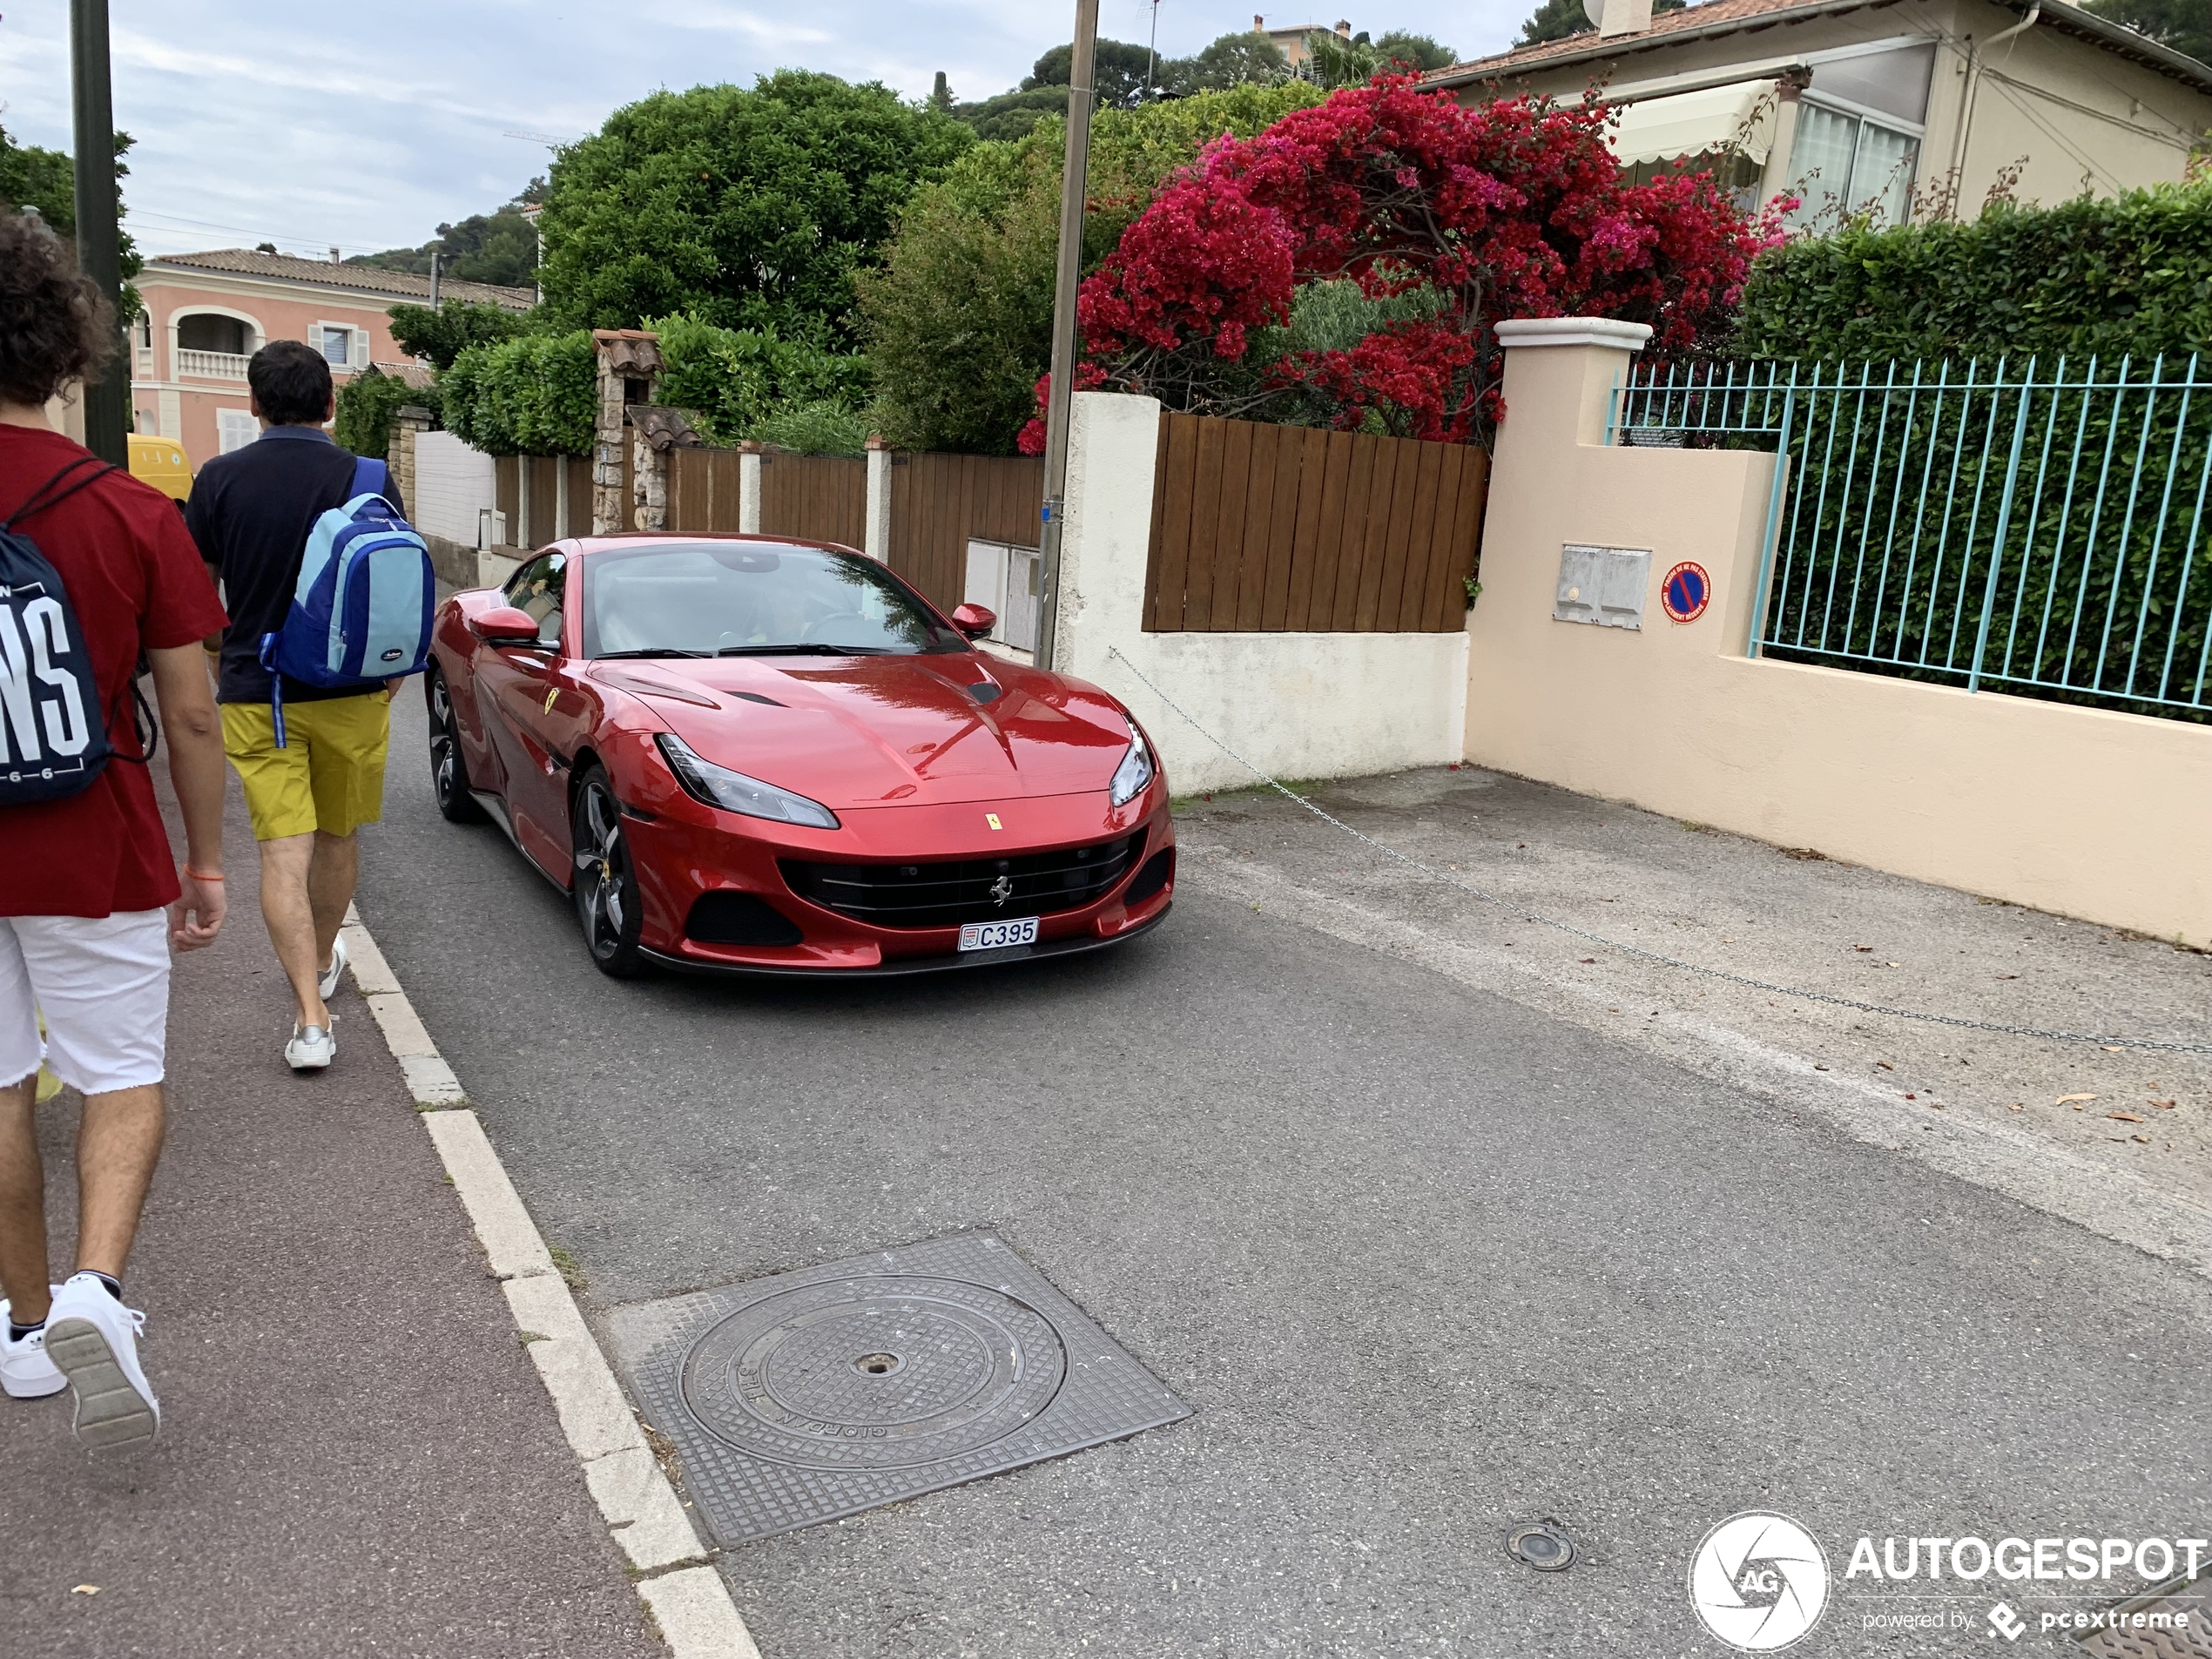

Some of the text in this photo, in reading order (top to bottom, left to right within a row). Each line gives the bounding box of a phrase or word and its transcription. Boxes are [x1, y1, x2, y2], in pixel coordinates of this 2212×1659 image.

[1664, 570, 1676, 587] PRIÈRE
[1698, 570, 1709, 600] STATIONNER
[1662, 592, 1684, 620] EMPLACEMENT
[981, 921, 1034, 946] C395
